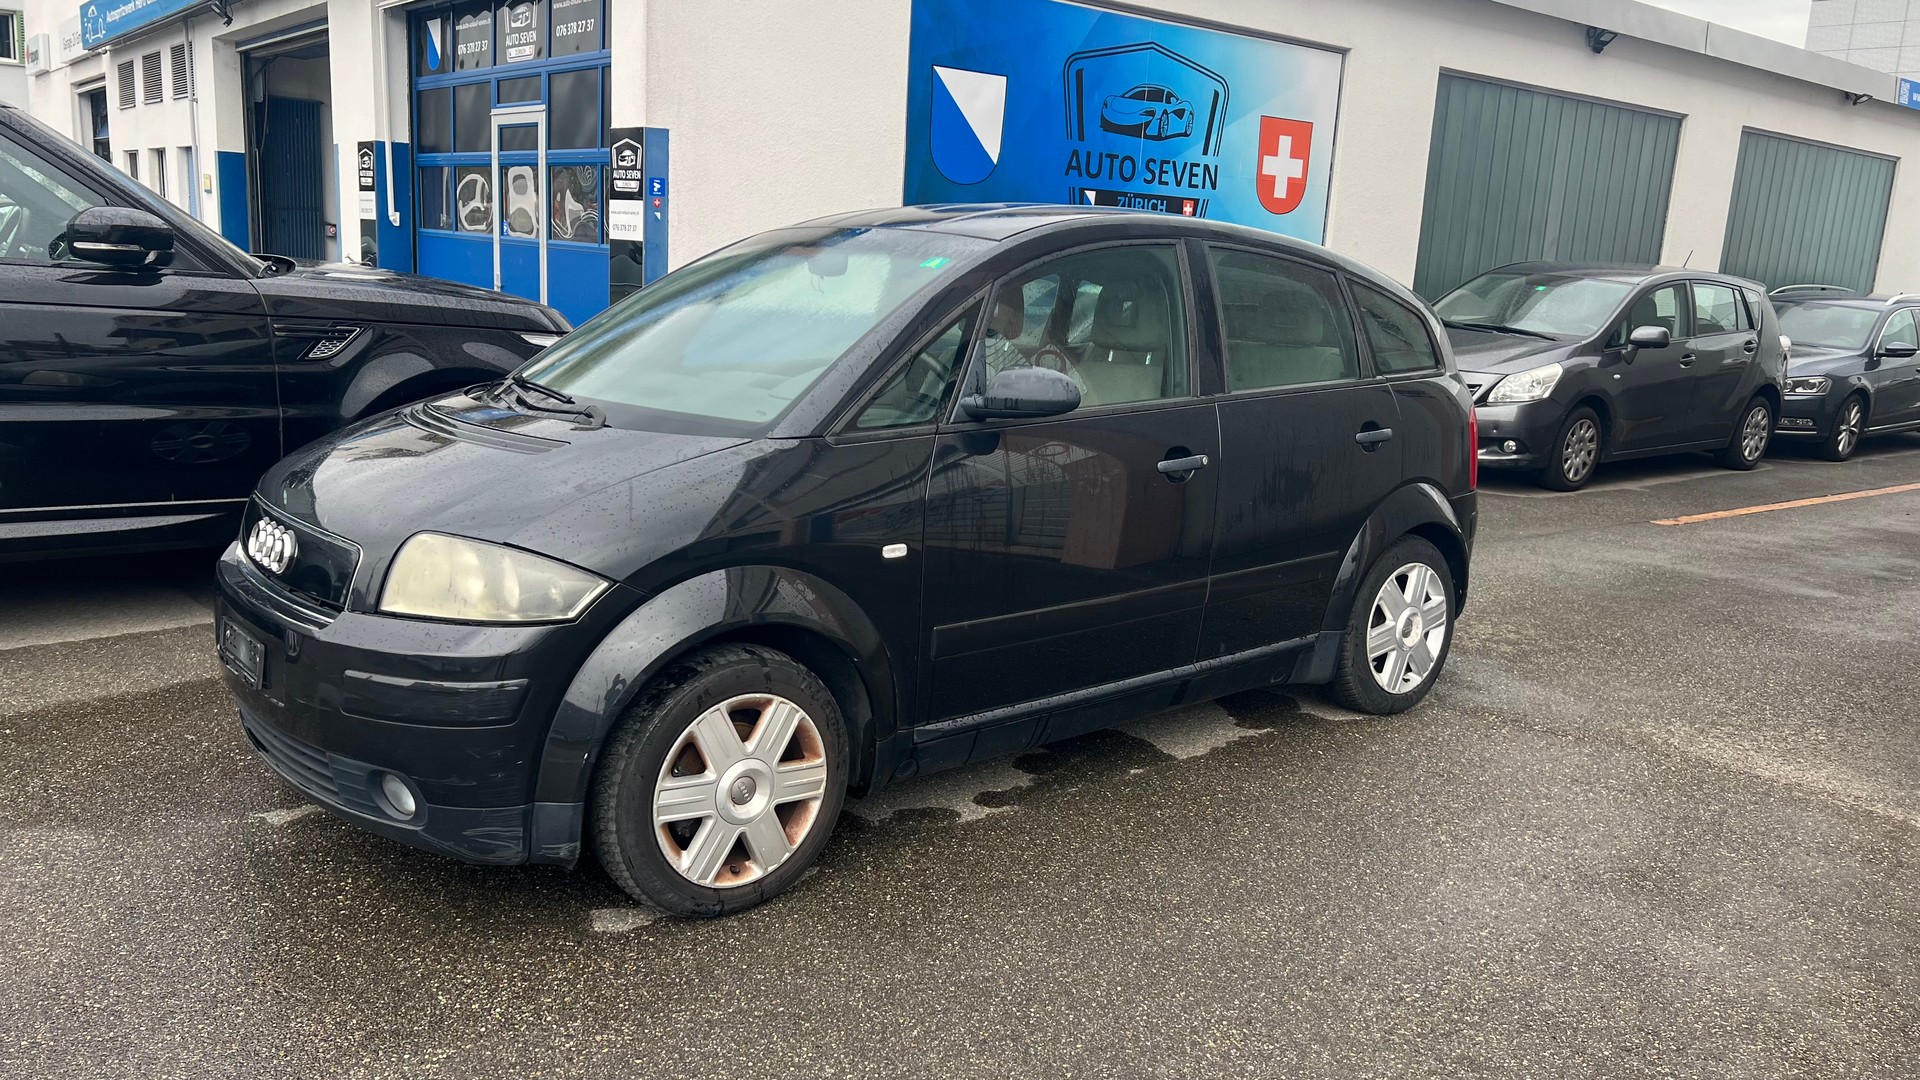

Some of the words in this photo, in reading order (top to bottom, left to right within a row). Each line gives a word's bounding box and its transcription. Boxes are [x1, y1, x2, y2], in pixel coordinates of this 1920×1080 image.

[556, 25, 567, 37] 076
[567, 22, 577, 35] 378
[578, 20, 586, 32] 27
[586, 18, 594, 32] 37
[505, 34, 520, 46] AUTO
[520, 30, 537, 44] SEVEN
[613, 170, 625, 179] AUTO
[626, 170, 641, 179] SEVEN
[1064, 149, 1137, 183] AUTO
[1143, 157, 1219, 191] SEVEN
[1117, 194, 1167, 212] ZÜRICH
